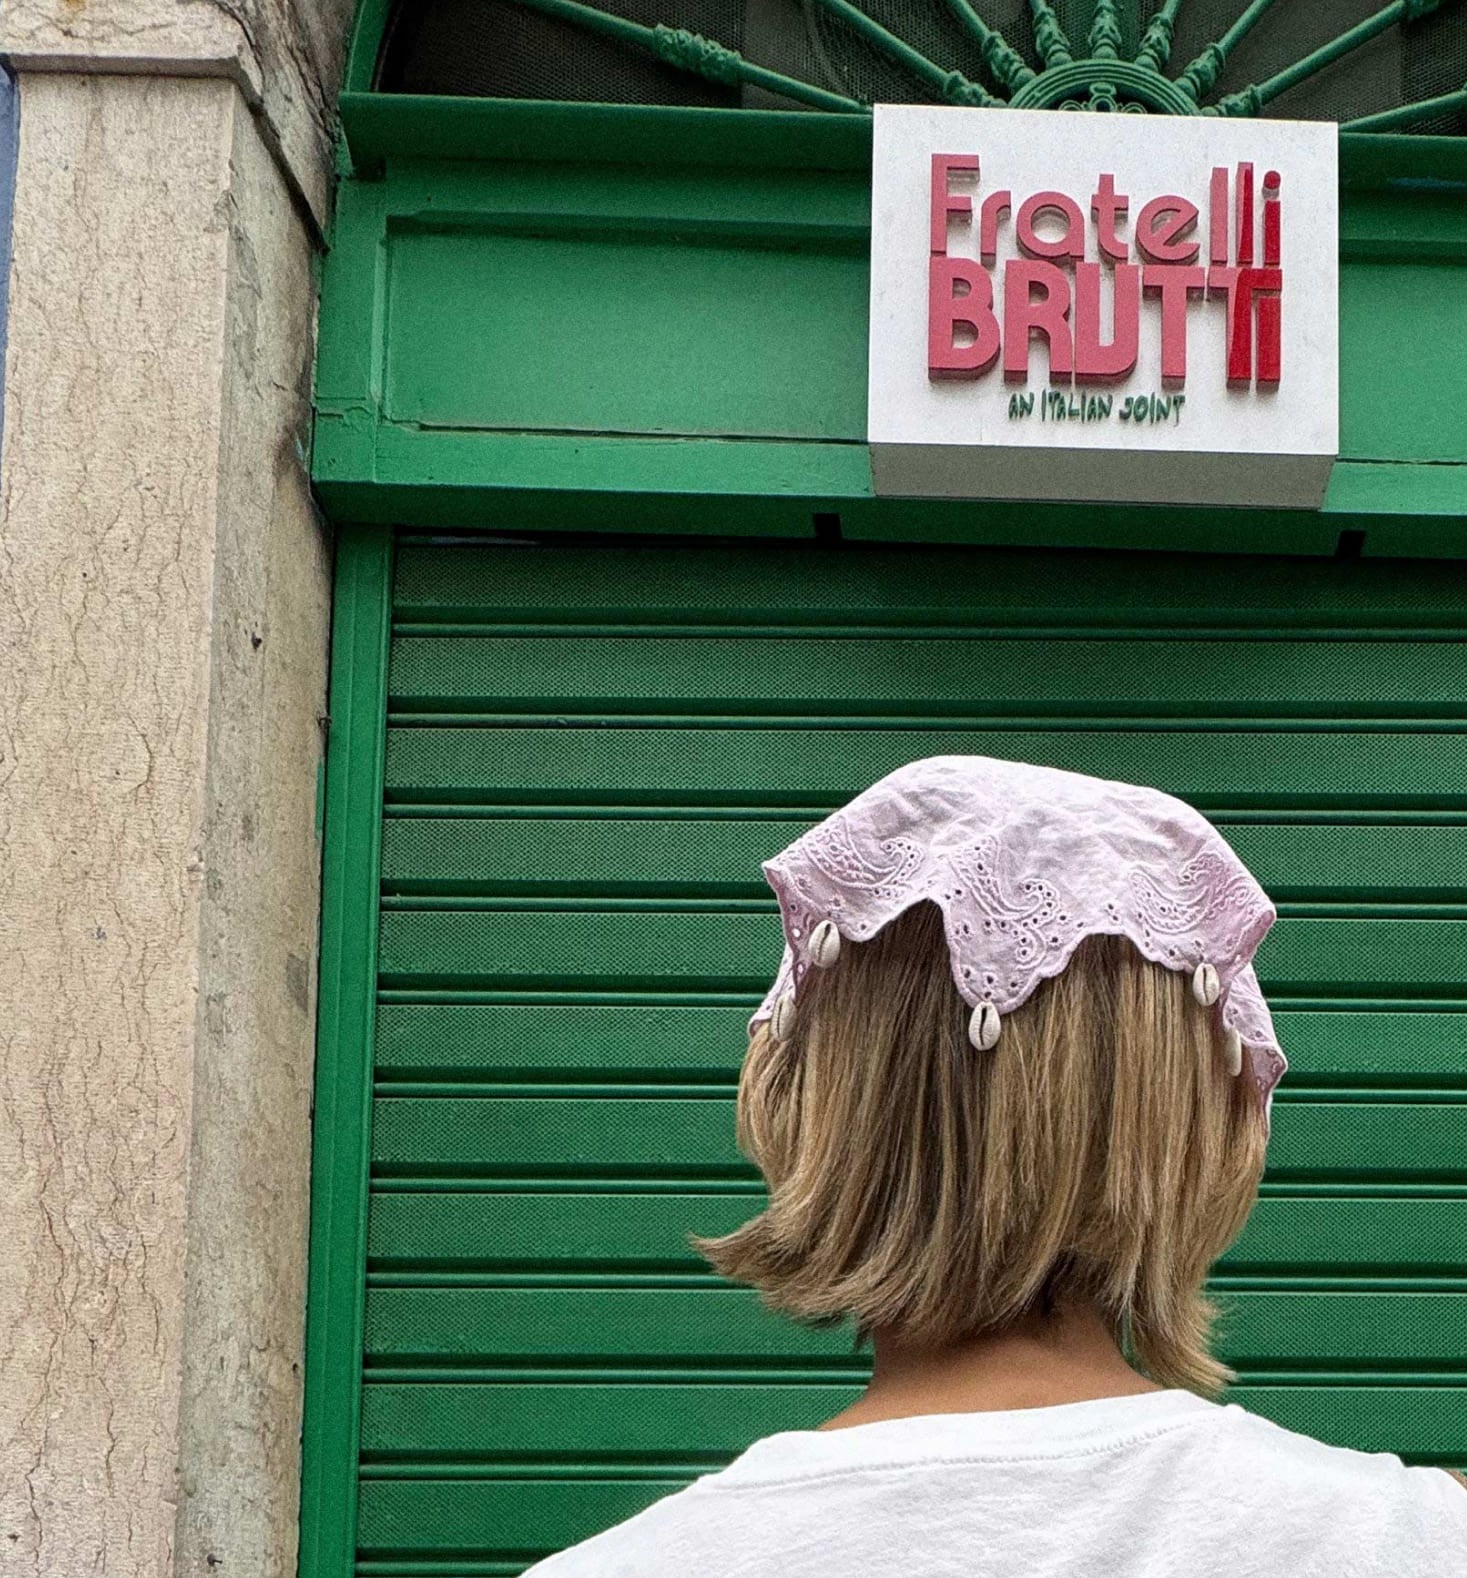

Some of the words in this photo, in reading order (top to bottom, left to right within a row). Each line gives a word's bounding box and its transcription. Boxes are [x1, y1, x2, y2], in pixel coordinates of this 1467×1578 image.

[929, 153, 1283, 266] Fratelli
[928, 256, 1283, 388] BRUTTI
[1008, 391, 1035, 421] AN
[1041, 388, 1114, 424] ITALIAN
[1119, 391, 1187, 427] JOINT
